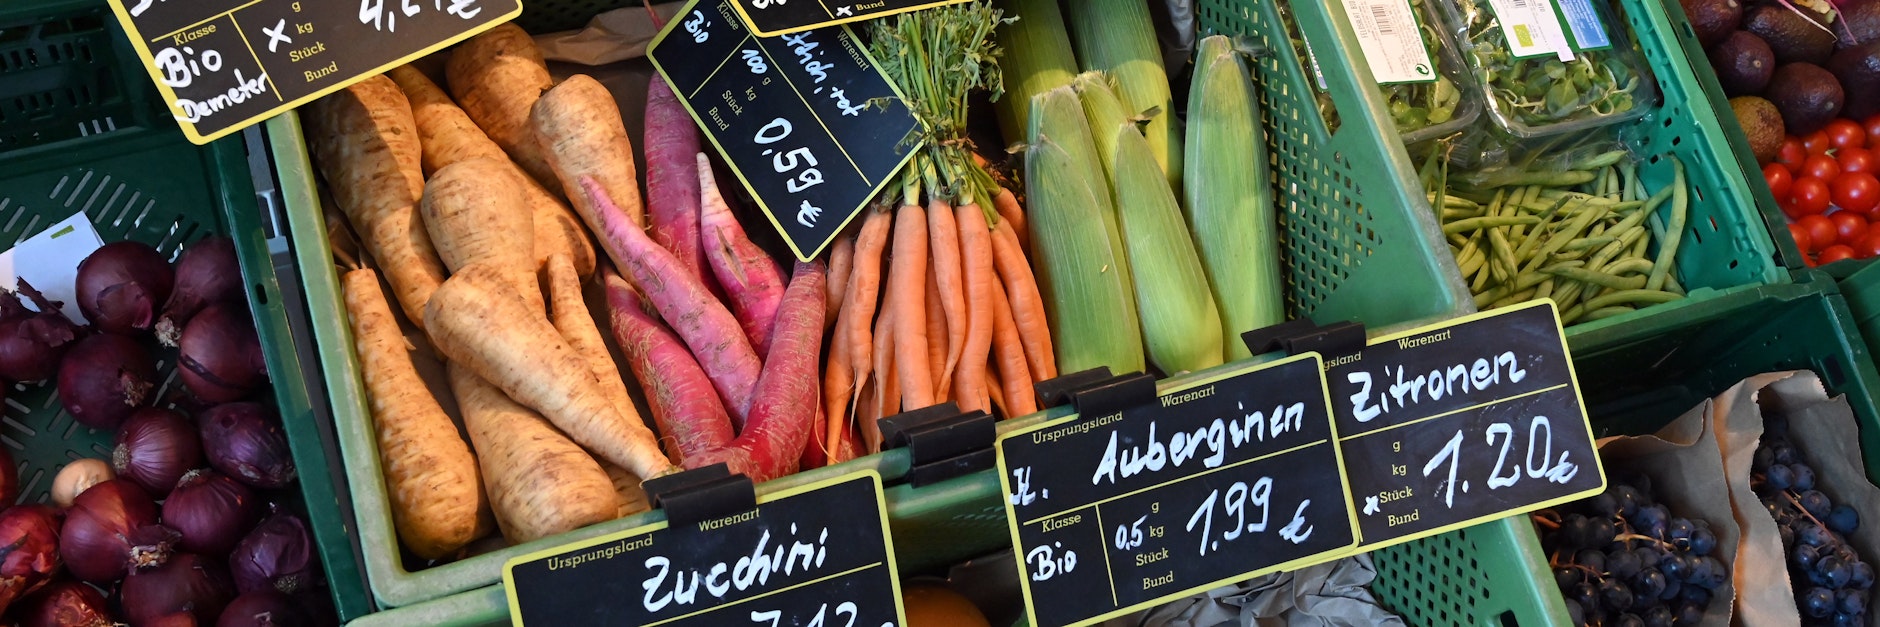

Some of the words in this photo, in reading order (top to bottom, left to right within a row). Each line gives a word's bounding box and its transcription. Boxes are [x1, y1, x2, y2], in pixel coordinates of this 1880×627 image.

[291, 1, 301, 13] g
[716, 3, 740, 31] Klasse
[855, 0, 885, 11] Bund
[173, 24, 217, 46] Klasse
[295, 22, 314, 34] kg
[684, 9, 709, 44] Bio
[289, 41, 326, 62] Stück
[836, 31, 871, 72] Warenart
[154, 46, 223, 88] Bio
[304, 60, 339, 82] Bund
[741, 49, 768, 75] 100
[762, 76, 772, 86] g
[174, 68, 267, 123] Demeter
[722, 89, 744, 117] Stück
[745, 86, 757, 101] kg
[829, 86, 866, 117] rot
[708, 106, 730, 132] Bund
[1397, 329, 1452, 351] Warenart
[1160, 384, 1216, 408] Warenart
[1347, 351, 1527, 423] Zitronen
[1032, 410, 1124, 445] Ursprungsland
[1092, 401, 1305, 485] Auberginen
[1392, 440, 1401, 453] g
[1391, 464, 1407, 477] kg
[1379, 486, 1413, 504] Stück
[1151, 501, 1160, 514] g
[1388, 509, 1420, 527] Bund
[698, 507, 760, 533] Warenart
[1041, 512, 1082, 533] Klasse
[1149, 524, 1165, 539] kg
[547, 533, 654, 571] Ursprungsland
[1026, 541, 1077, 582] Bio
[1135, 547, 1169, 567] Stück
[642, 522, 829, 613] Zucchini
[1142, 571, 1174, 591] Bund
